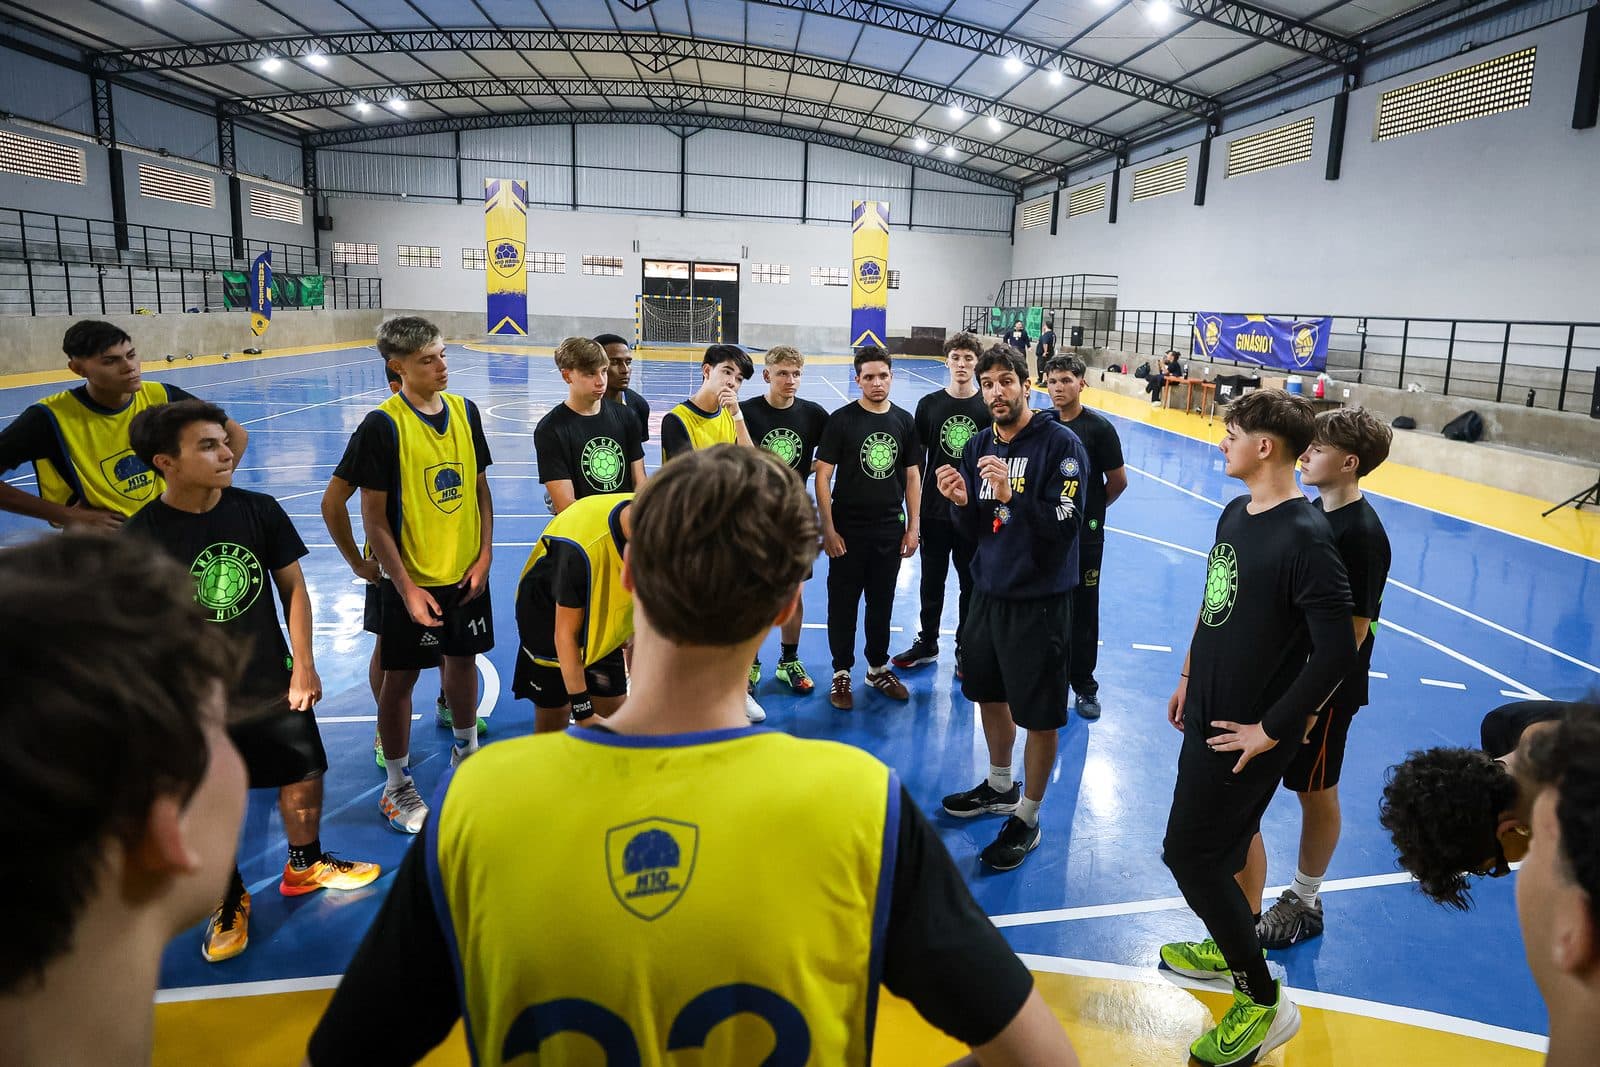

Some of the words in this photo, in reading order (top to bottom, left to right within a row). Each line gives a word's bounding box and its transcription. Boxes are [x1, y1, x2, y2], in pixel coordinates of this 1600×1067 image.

[1235, 330, 1268, 353] GINÁSIO
[1061, 480, 1079, 498] 26
[221, 545, 258, 570] CAMP
[468, 617, 487, 636] 11
